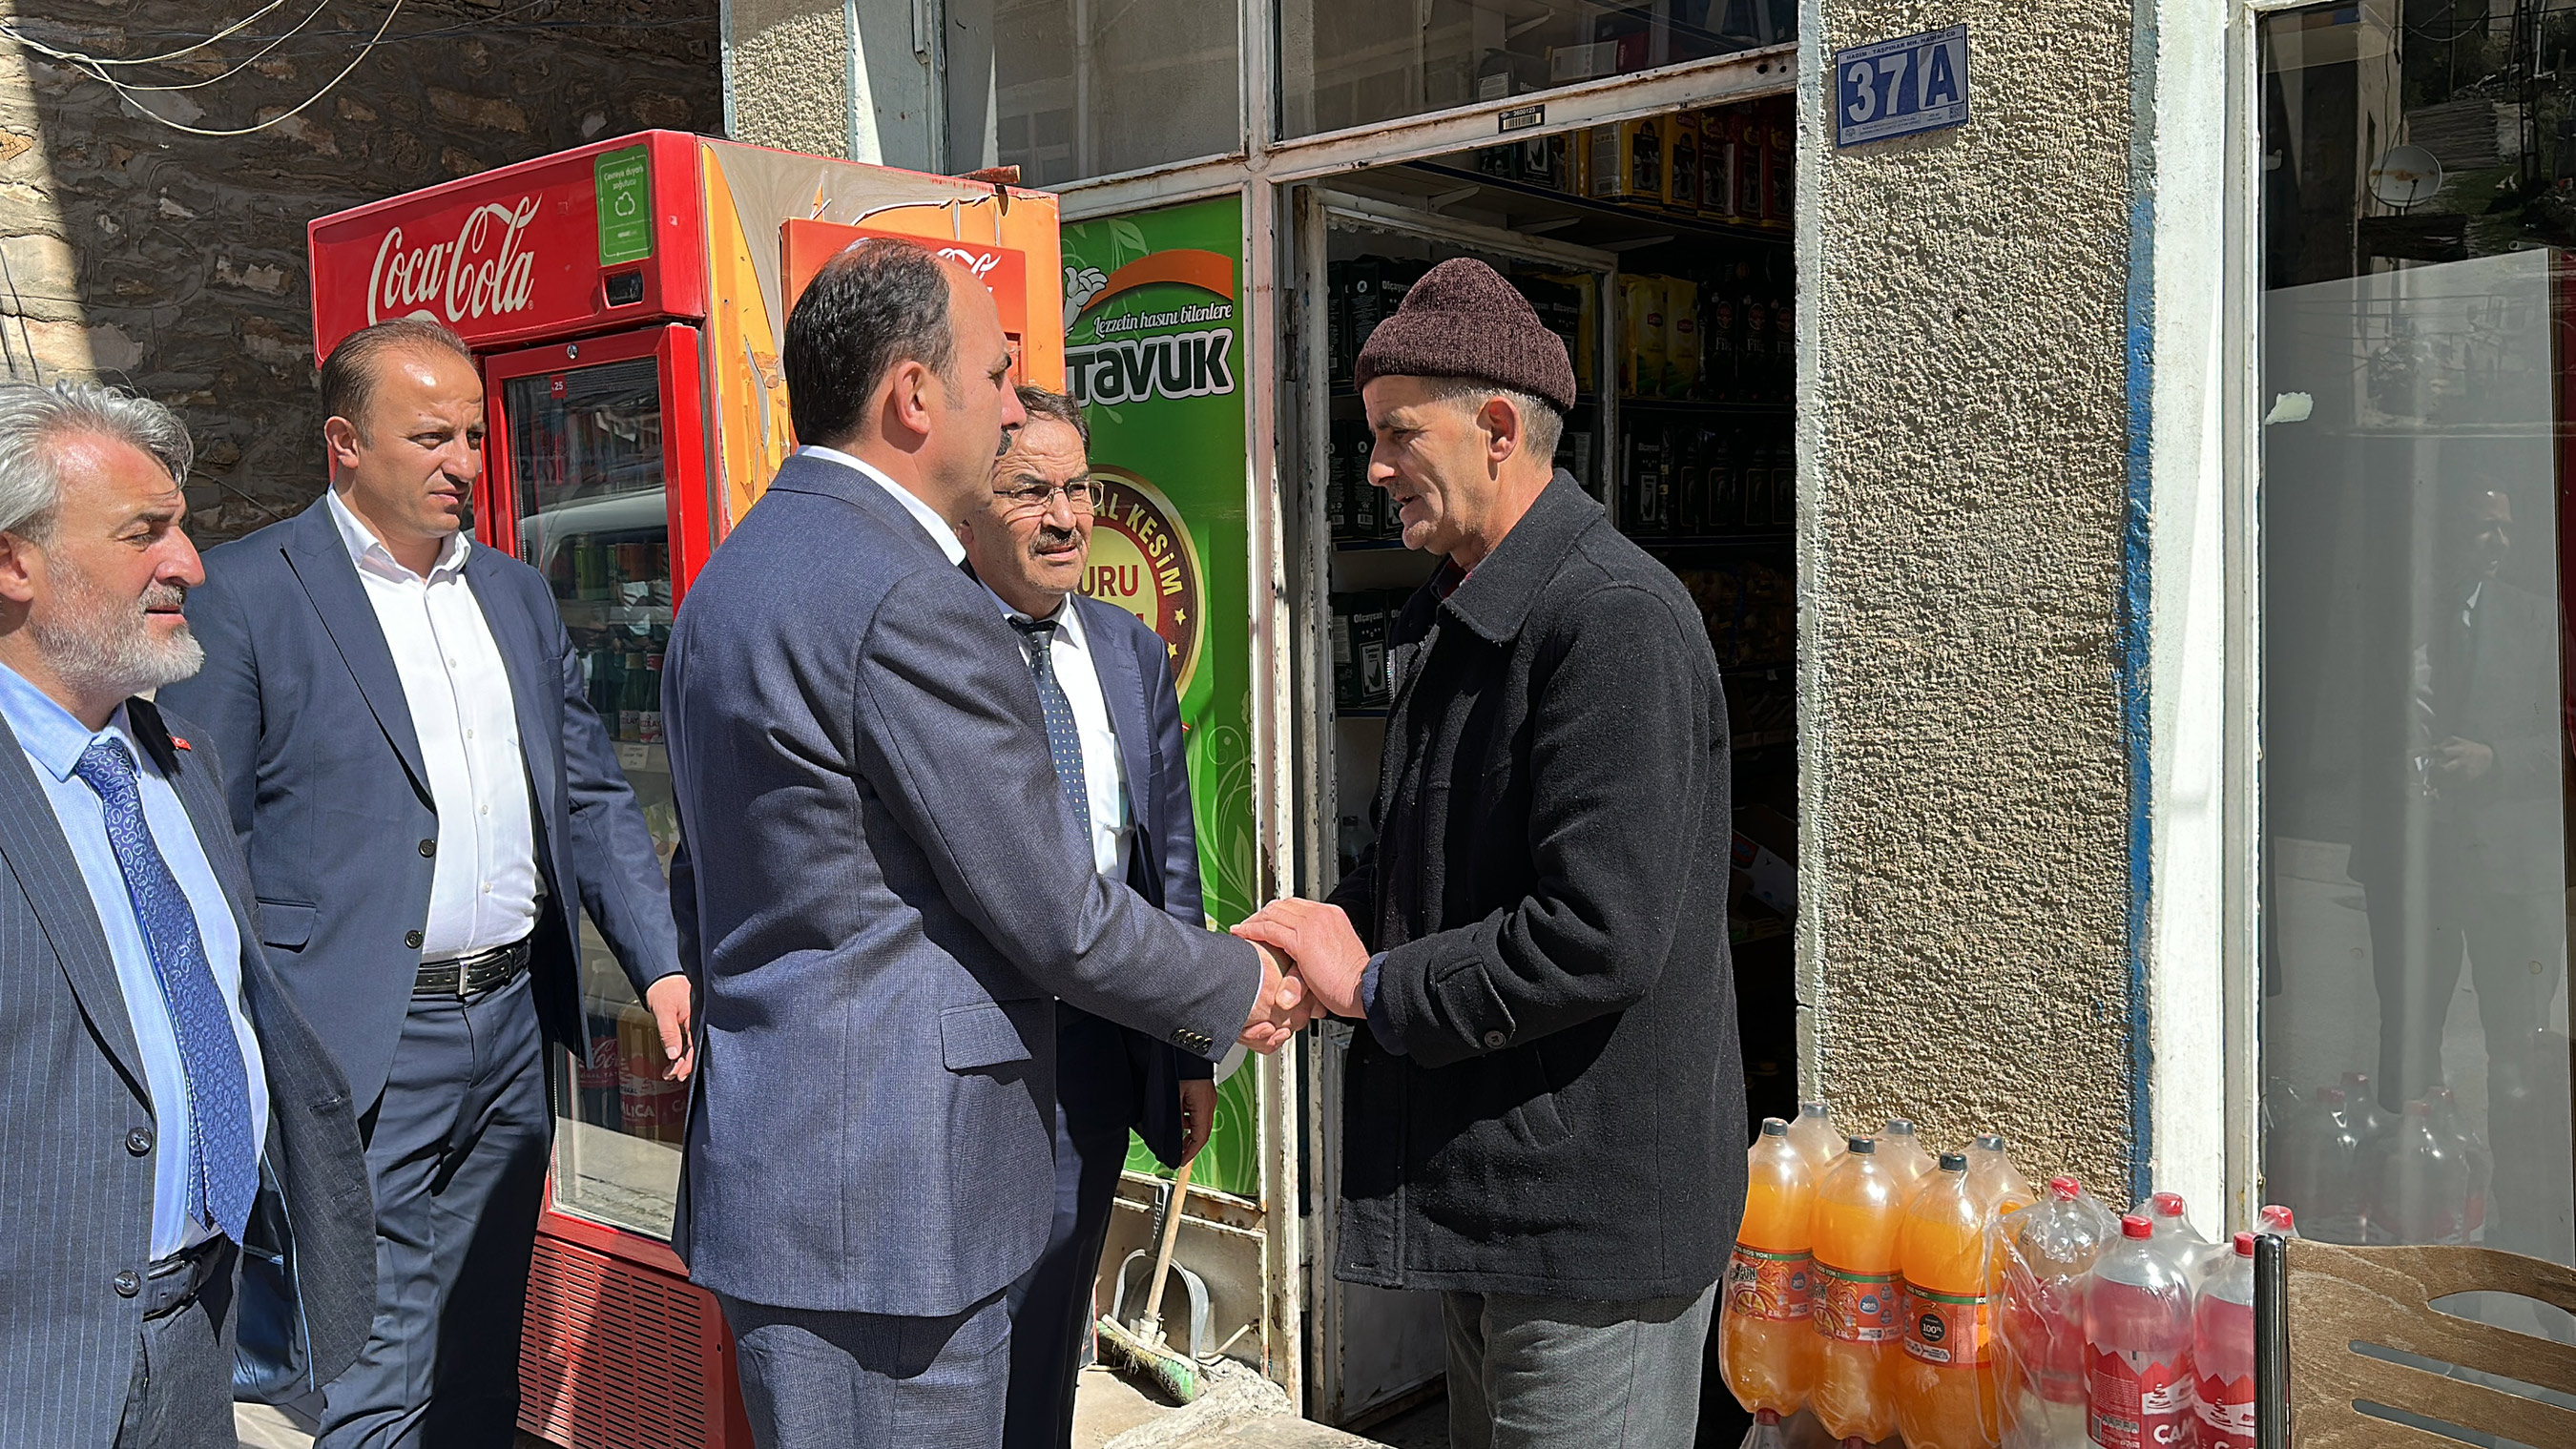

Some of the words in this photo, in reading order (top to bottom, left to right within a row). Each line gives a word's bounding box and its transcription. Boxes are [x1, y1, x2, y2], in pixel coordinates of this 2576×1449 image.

[1847, 52, 1908, 123] 37
[1924, 43, 1959, 107] A
[367, 192, 543, 326] Coca-Cola
[1093, 314, 1138, 338] Lezzetin
[1139, 311, 1179, 329] hasını
[1179, 302, 1234, 325] bilenlere
[1076, 564, 1139, 598] URU
